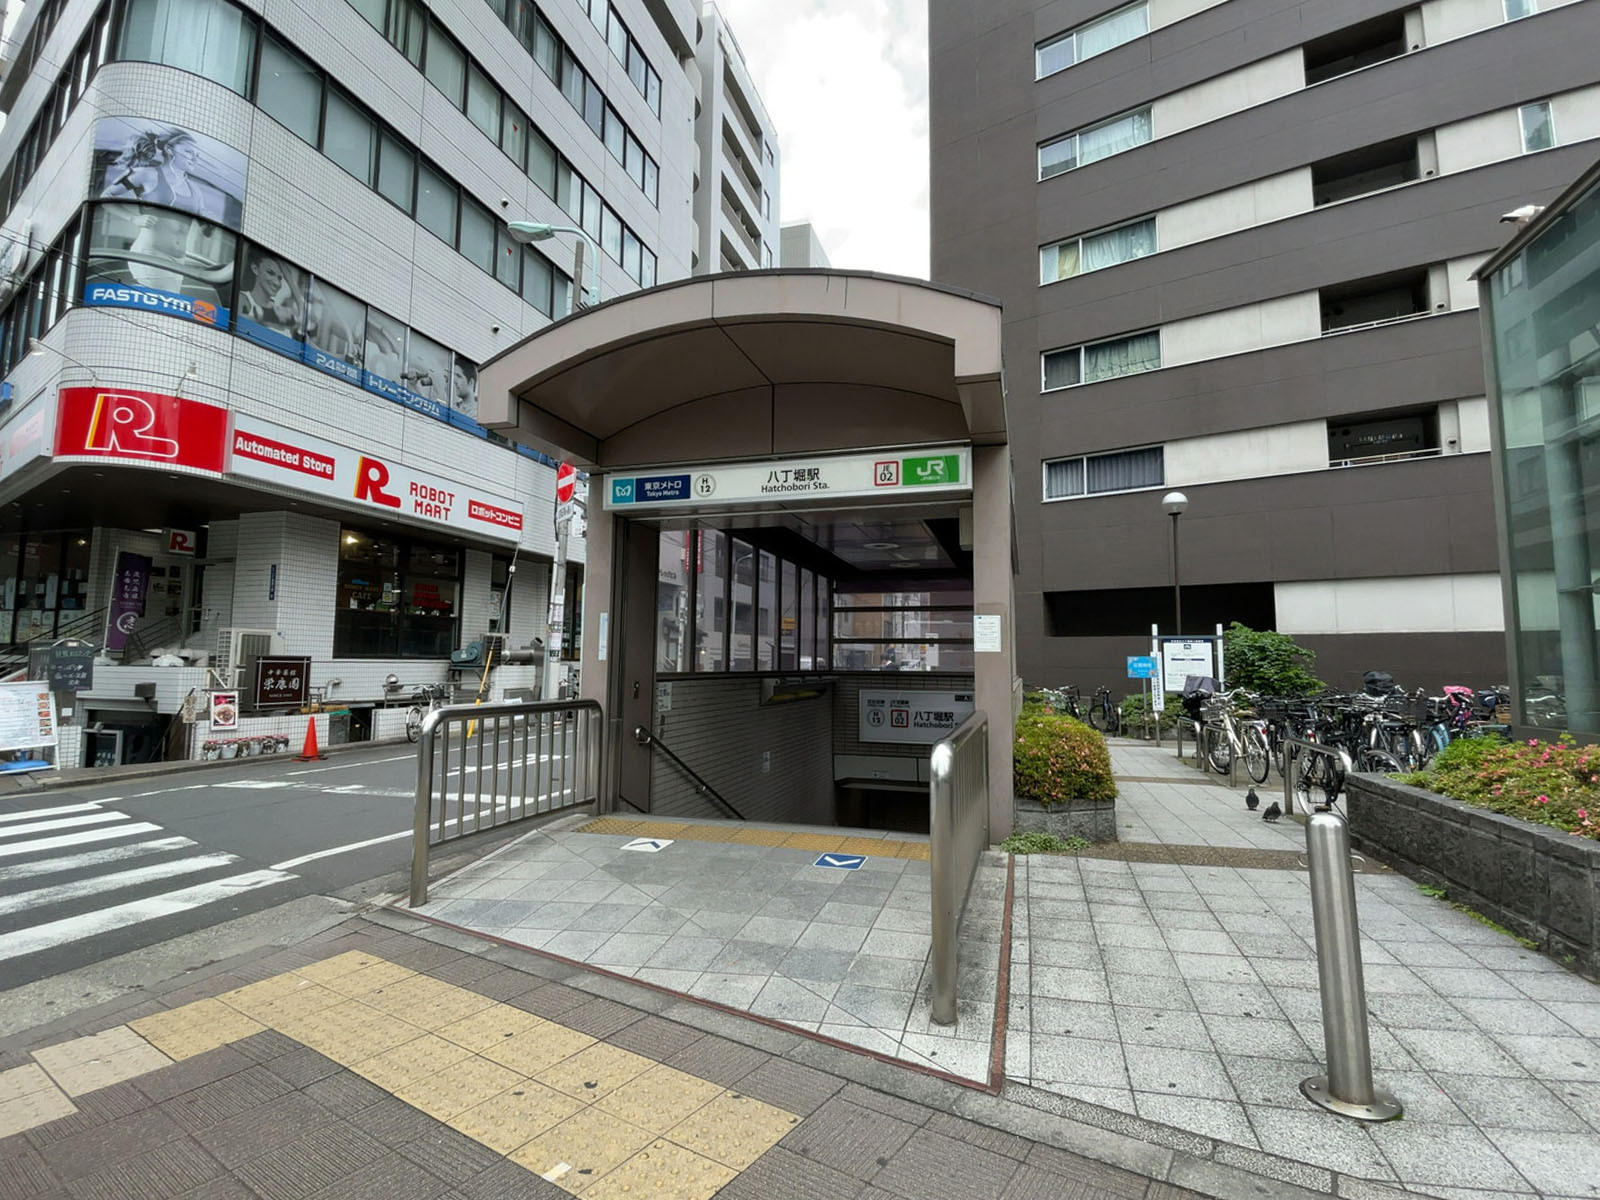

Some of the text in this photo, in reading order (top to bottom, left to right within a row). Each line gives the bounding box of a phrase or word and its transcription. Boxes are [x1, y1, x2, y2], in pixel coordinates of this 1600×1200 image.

[84, 393, 179, 458] R
[235, 436, 333, 474] Automated Store
[767, 467, 820, 483] 八丁堀駅
[882, 464, 891, 472] JE
[916, 459, 944, 476] JR
[353, 455, 402, 508] R
[644, 480, 682, 490] 東京メトロ
[701, 477, 709, 485] H
[880, 472, 893, 482] 02
[409, 481, 455, 507] ROBOT
[646, 489, 680, 498] Tokyo Metro
[700, 485, 711, 493] 12
[761, 480, 830, 493] Hatchobori Sta.
[413, 499, 451, 521] MART
[471, 505, 520, 527] ロボットコンビニ
[170, 532, 194, 552] R
[913, 711, 954, 722] 八丁堀駅
